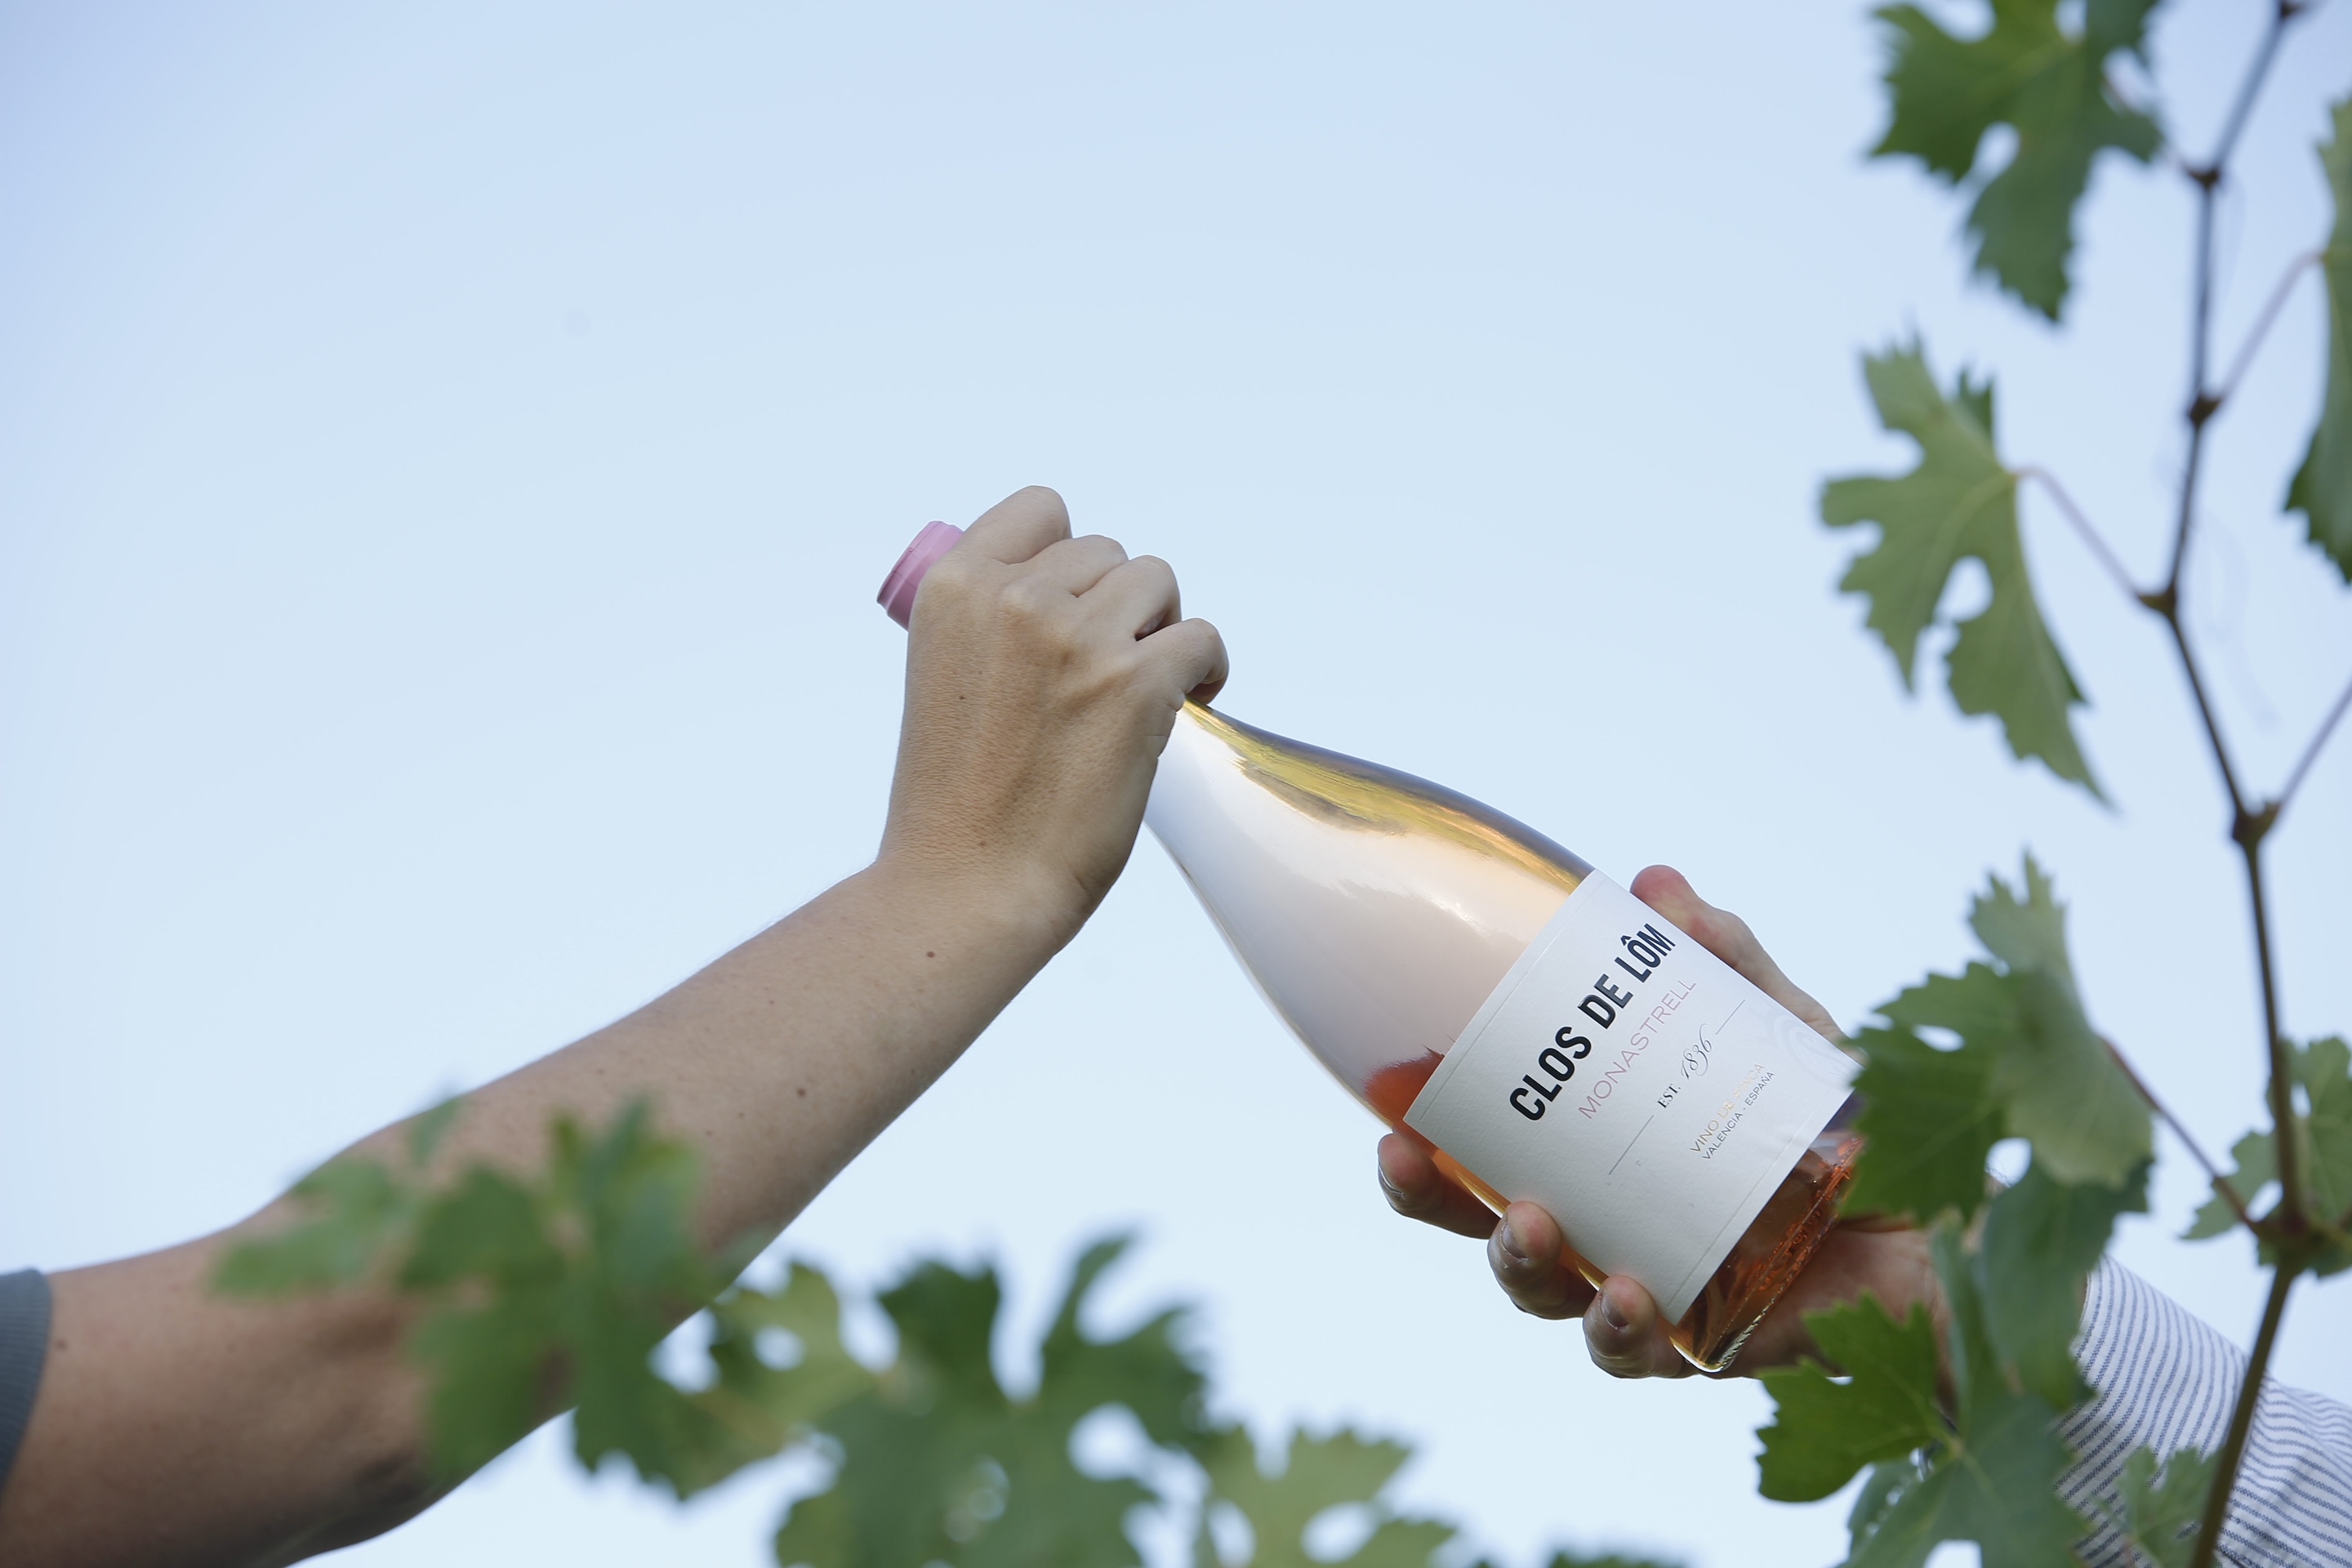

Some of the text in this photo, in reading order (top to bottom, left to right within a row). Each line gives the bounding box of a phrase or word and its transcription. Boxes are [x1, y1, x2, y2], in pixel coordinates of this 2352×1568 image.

[1509, 923, 1676, 1120] CLOS DE LÔM
[1578, 980, 1696, 1119] MONASTRELL
[1657, 1023, 1712, 1108] EST. 1836
[1690, 1063, 1765, 1152] VINO DE FINCA
[1702, 1112, 1743, 1159] VALENCIA
[1744, 1071, 1775, 1106] ESPAÑA
